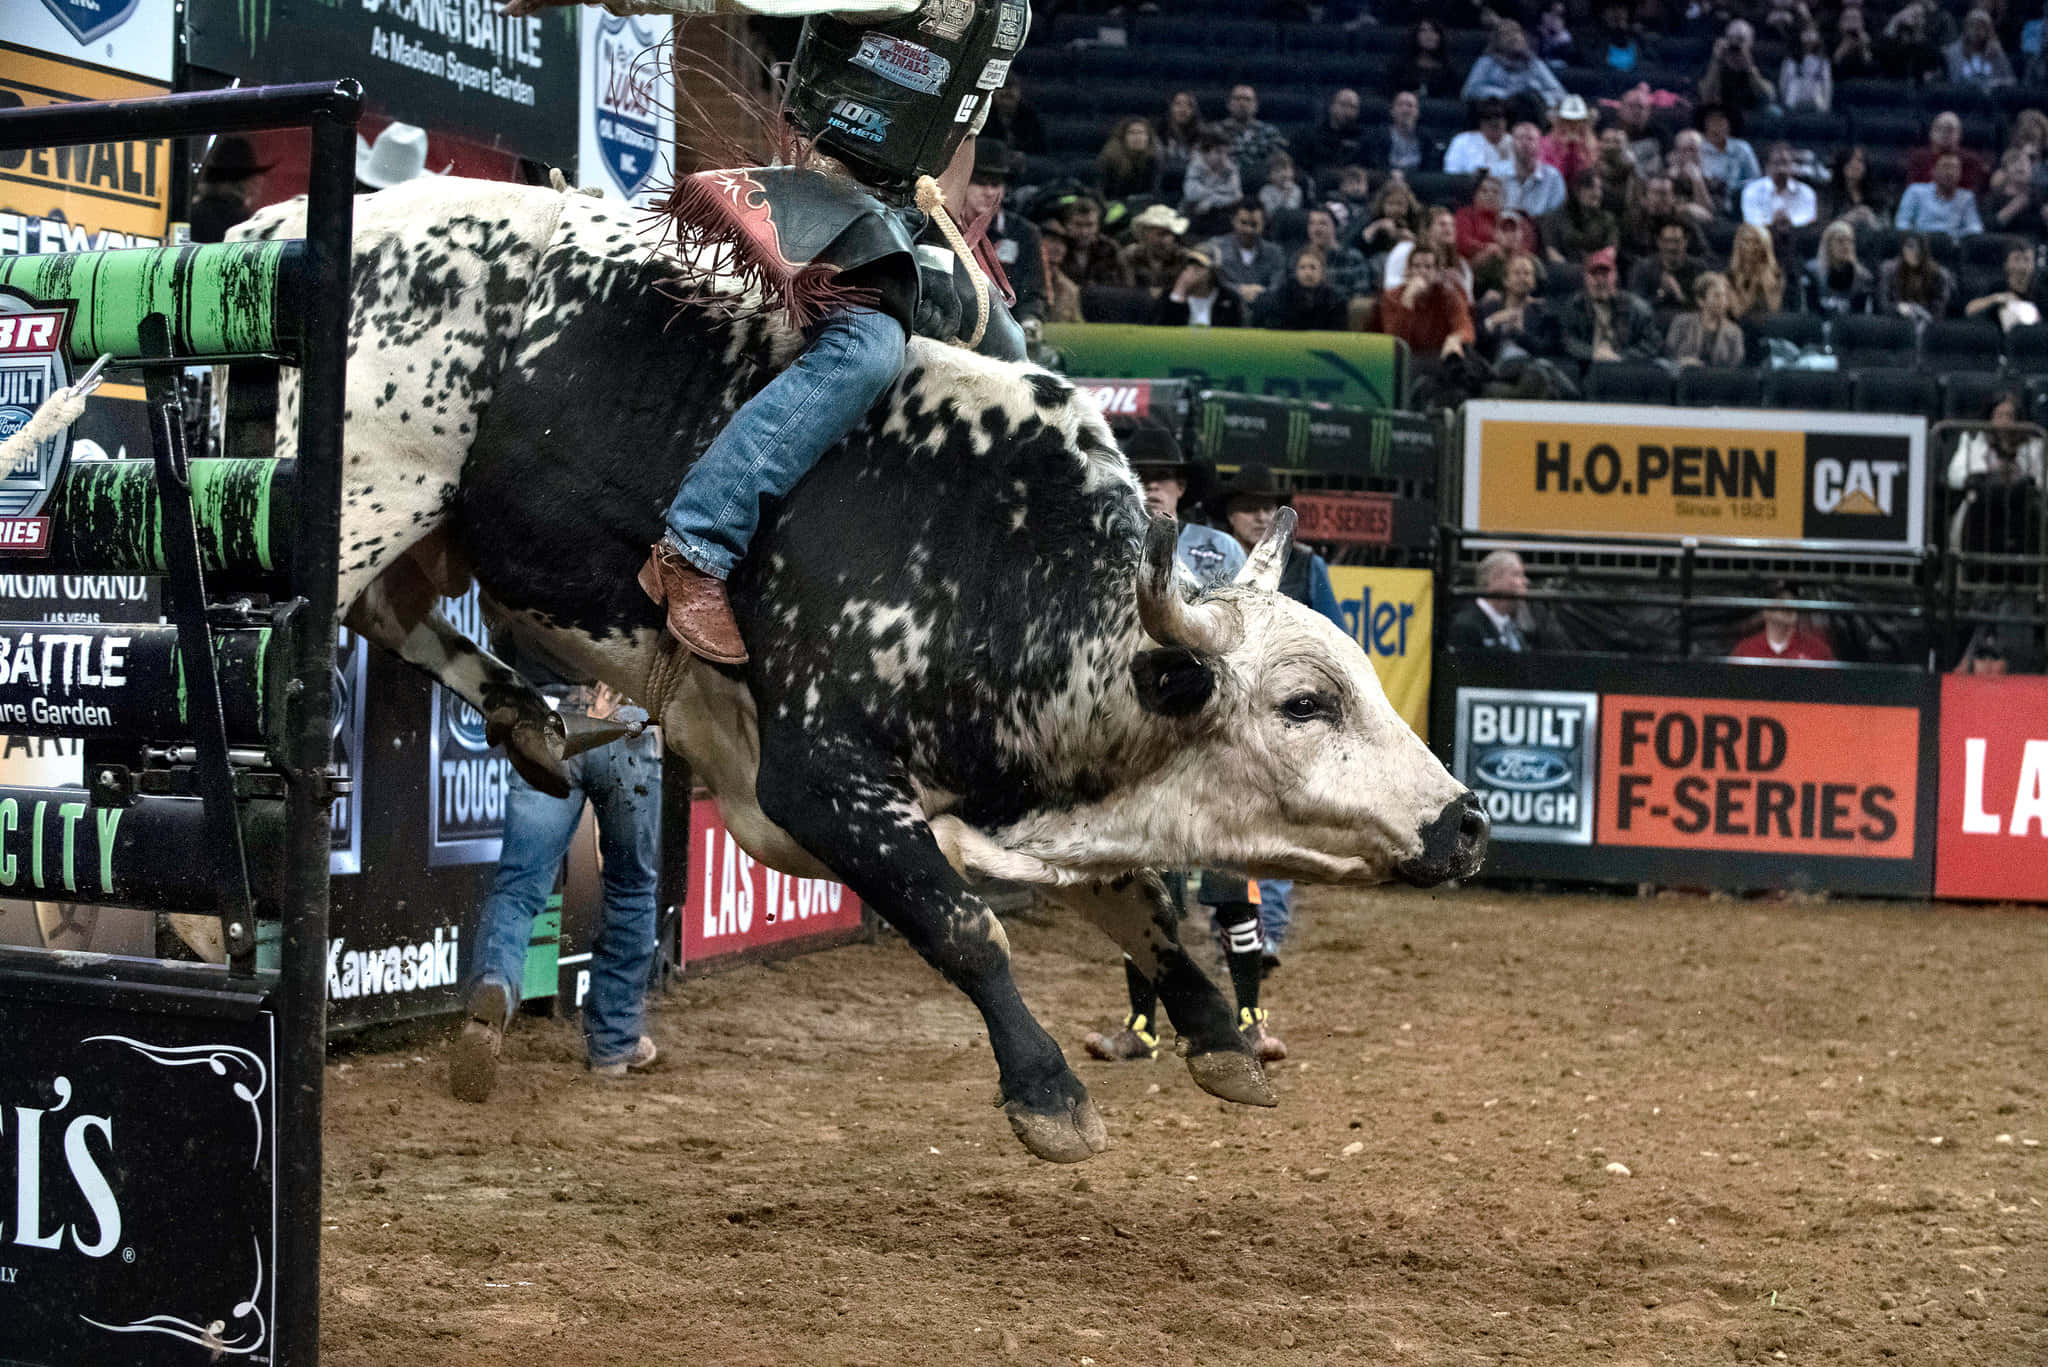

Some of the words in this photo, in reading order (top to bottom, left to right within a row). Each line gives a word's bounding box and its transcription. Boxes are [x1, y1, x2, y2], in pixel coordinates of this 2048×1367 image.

[465, 0, 543, 69] BATTLE
[371, 26, 388, 59] At
[390, 31, 445, 77] Madison
[446, 51, 490, 92] Square
[491, 66, 535, 106] Garden
[1675, 502, 1722, 518] Since
[1813, 458, 1901, 516] CAT
[44, 613, 65, 623] LAS
[66, 613, 101, 623] VEGAS
[63, 575, 146, 600] GRAND
[32, 697, 113, 726] Garden
[1472, 704, 1581, 748] BUILT
[1619, 710, 1788, 772] FORD
[1496, 751, 1551, 779] Ford
[1617, 774, 1898, 842] F-SERIES
[0, 797, 124, 894] CITY
[703, 827, 755, 938] LAS
[326, 925, 459, 1000] Kawasaki
[0, 1076, 122, 1257] L'S
